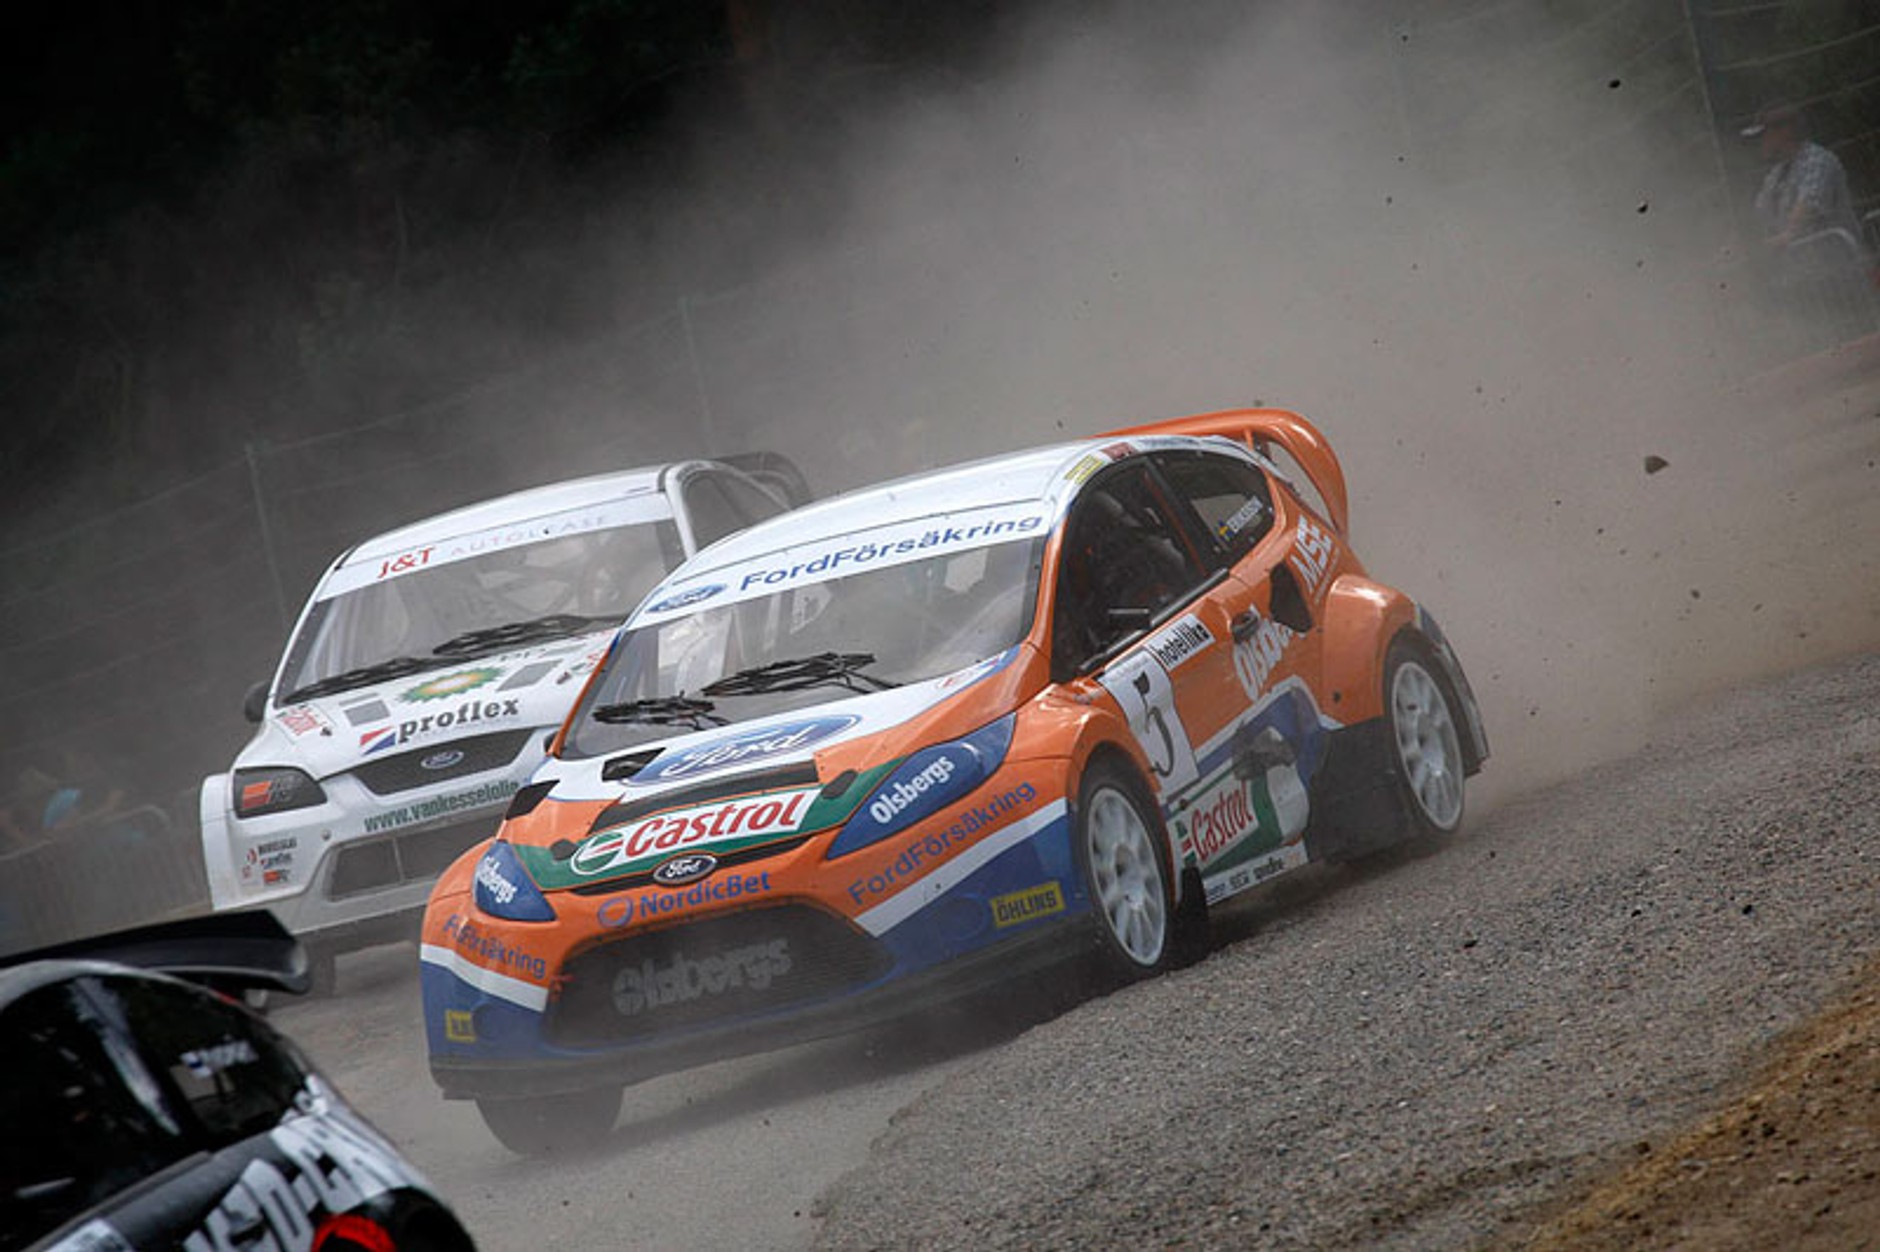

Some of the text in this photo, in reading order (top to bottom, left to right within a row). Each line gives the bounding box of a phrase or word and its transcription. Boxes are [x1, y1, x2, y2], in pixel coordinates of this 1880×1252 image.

[378, 547, 435, 579] J&T
[740, 515, 1043, 591] FordFörsäkring
[398, 698, 520, 744] proflex
[660, 724, 819, 777] Ford
[869, 755, 956, 824] Olsbergs
[1191, 778, 1254, 862] Castrol
[626, 793, 805, 858] Castrol
[847, 781, 1038, 906] FordFörsäkring
[639, 871, 772, 918] NordicBet
